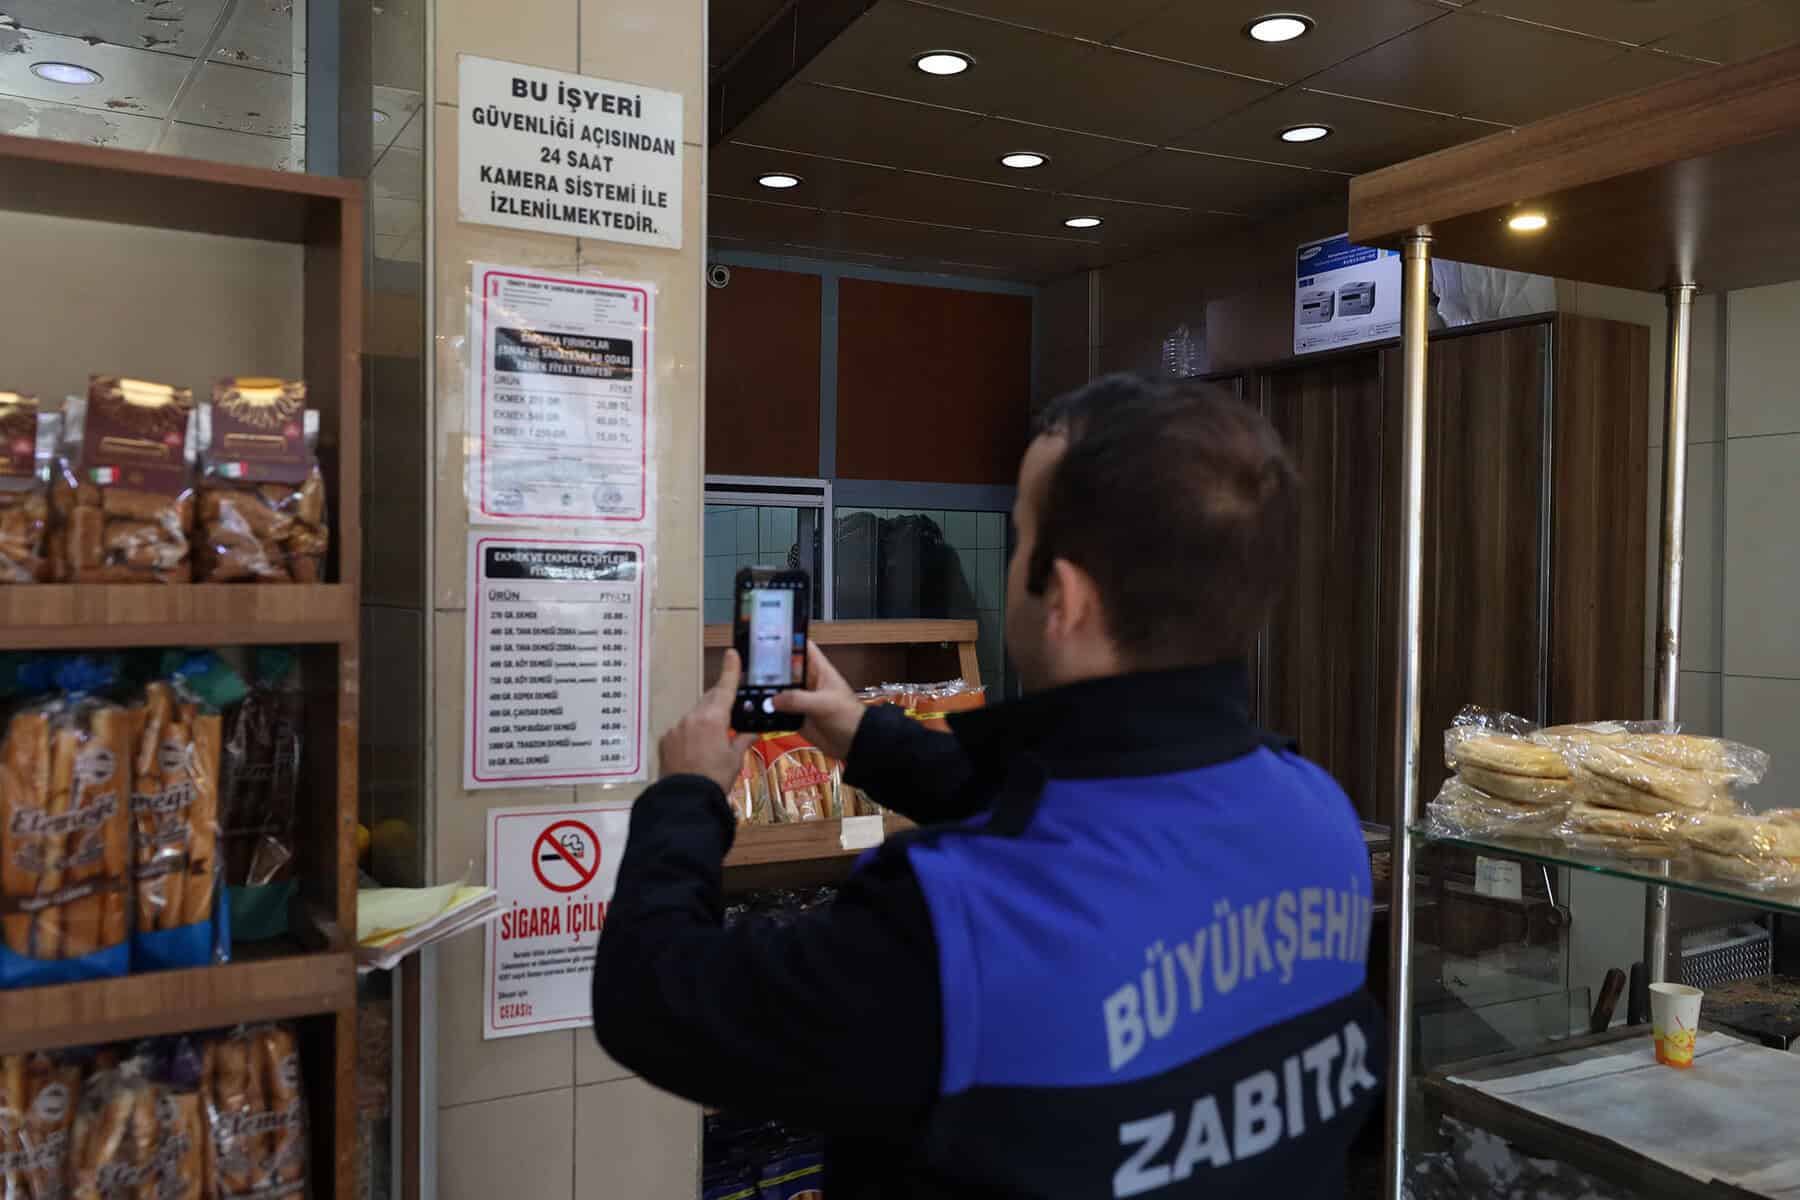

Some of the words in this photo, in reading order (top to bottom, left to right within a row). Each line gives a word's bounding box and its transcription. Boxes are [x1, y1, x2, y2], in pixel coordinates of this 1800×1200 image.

[512, 78, 548, 102] BU
[559, 81, 641, 118] İŞYERİ
[472, 105, 574, 140] GÜVENLİĞİ
[581, 126, 675, 156] AÇISINDAN
[541, 147, 561, 164] 24
[568, 151, 613, 173] SAAT
[481, 165, 559, 193] KAMERA
[566, 175, 636, 204] SİSTEMİ
[642, 184, 667, 209] İLE
[491, 190, 658, 234] İZLENİLMEKTEDİR.
[488, 589, 520, 601] ÜRÜN
[501, 901, 561, 941] SİGARA
[566, 895, 612, 942] İÇİLM
[1112, 1019, 1378, 1199] ZABITA
